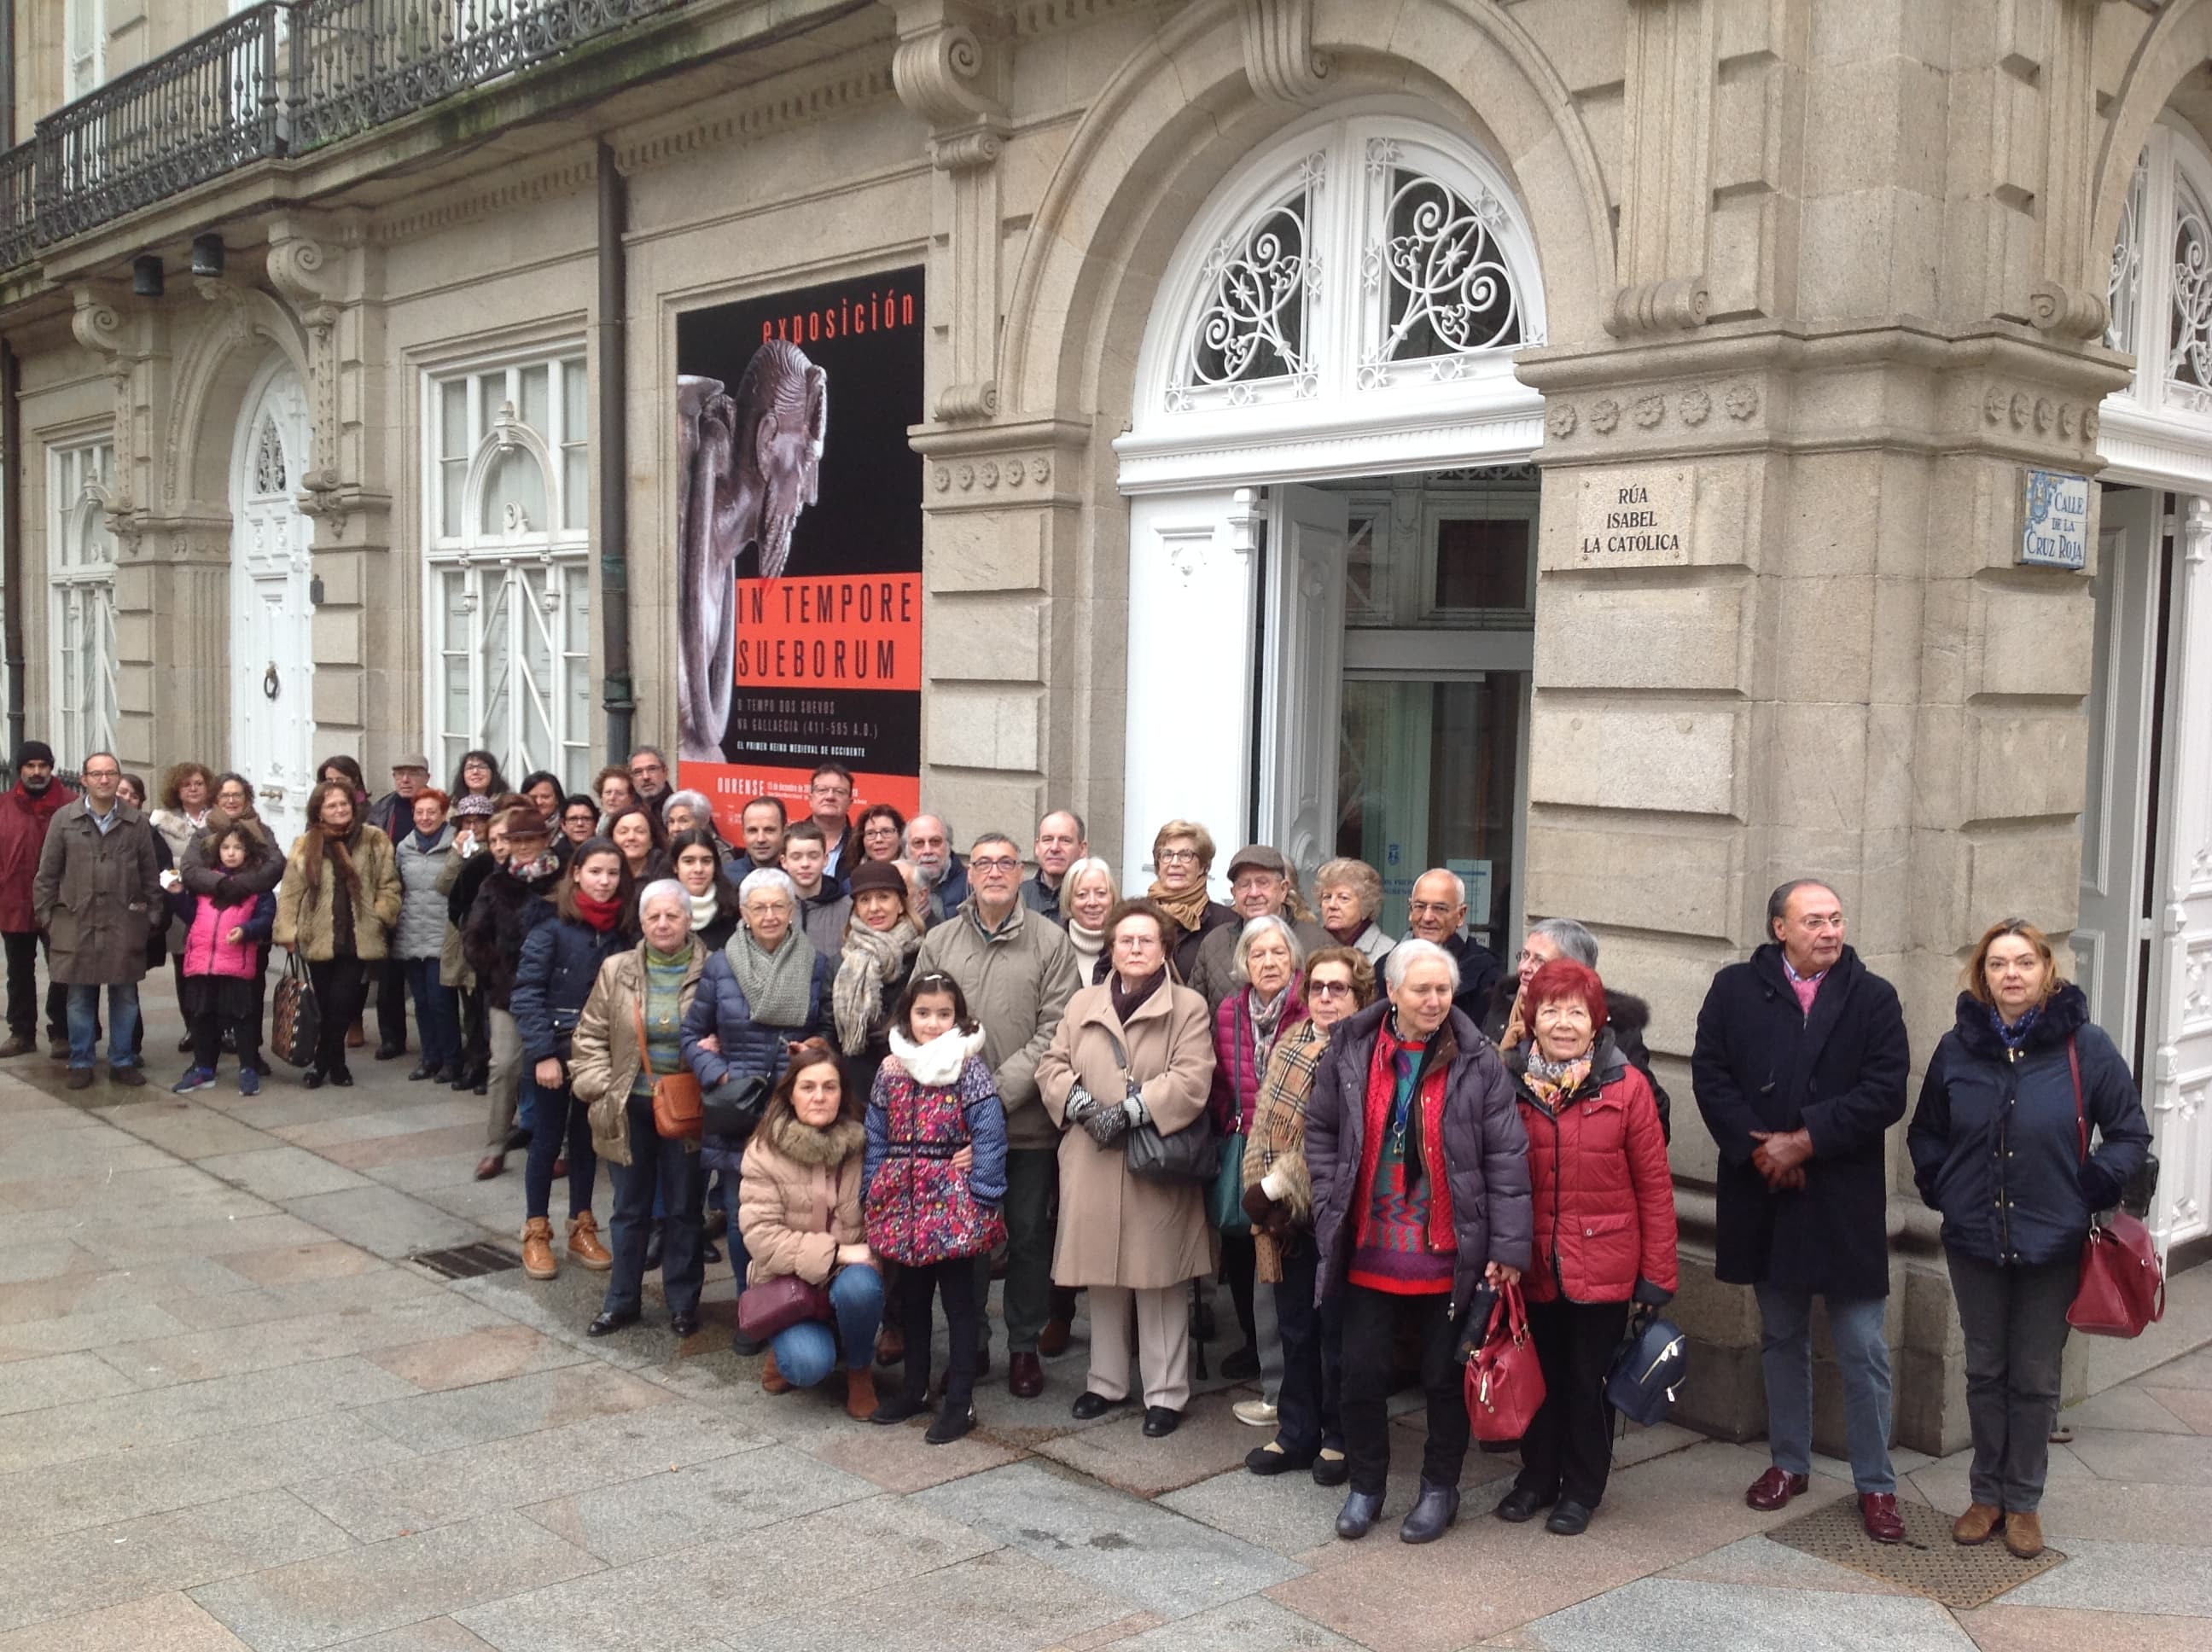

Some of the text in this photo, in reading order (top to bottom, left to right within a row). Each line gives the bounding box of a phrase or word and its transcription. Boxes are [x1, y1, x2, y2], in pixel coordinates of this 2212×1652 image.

[762, 288, 915, 346] exposición
[1618, 484, 1648, 505] RÚA
[2054, 492, 2084, 515] CALLE
[1607, 510, 1658, 529] ISABEL
[2051, 517, 2075, 532] DE LA
[1583, 531, 1679, 554] LA CATÓLICA
[2026, 531, 2083, 561] CRUZ ROJA
[737, 582, 911, 624] IN TEMPORE
[737, 639, 895, 679] SUEBORUM
[747, 698, 775, 713] TEMPO
[778, 699, 796, 713] DOS
[800, 700, 835, 715] SUEVOS
[736, 740, 744, 750] EL
[717, 777, 765, 796] OURENSE
